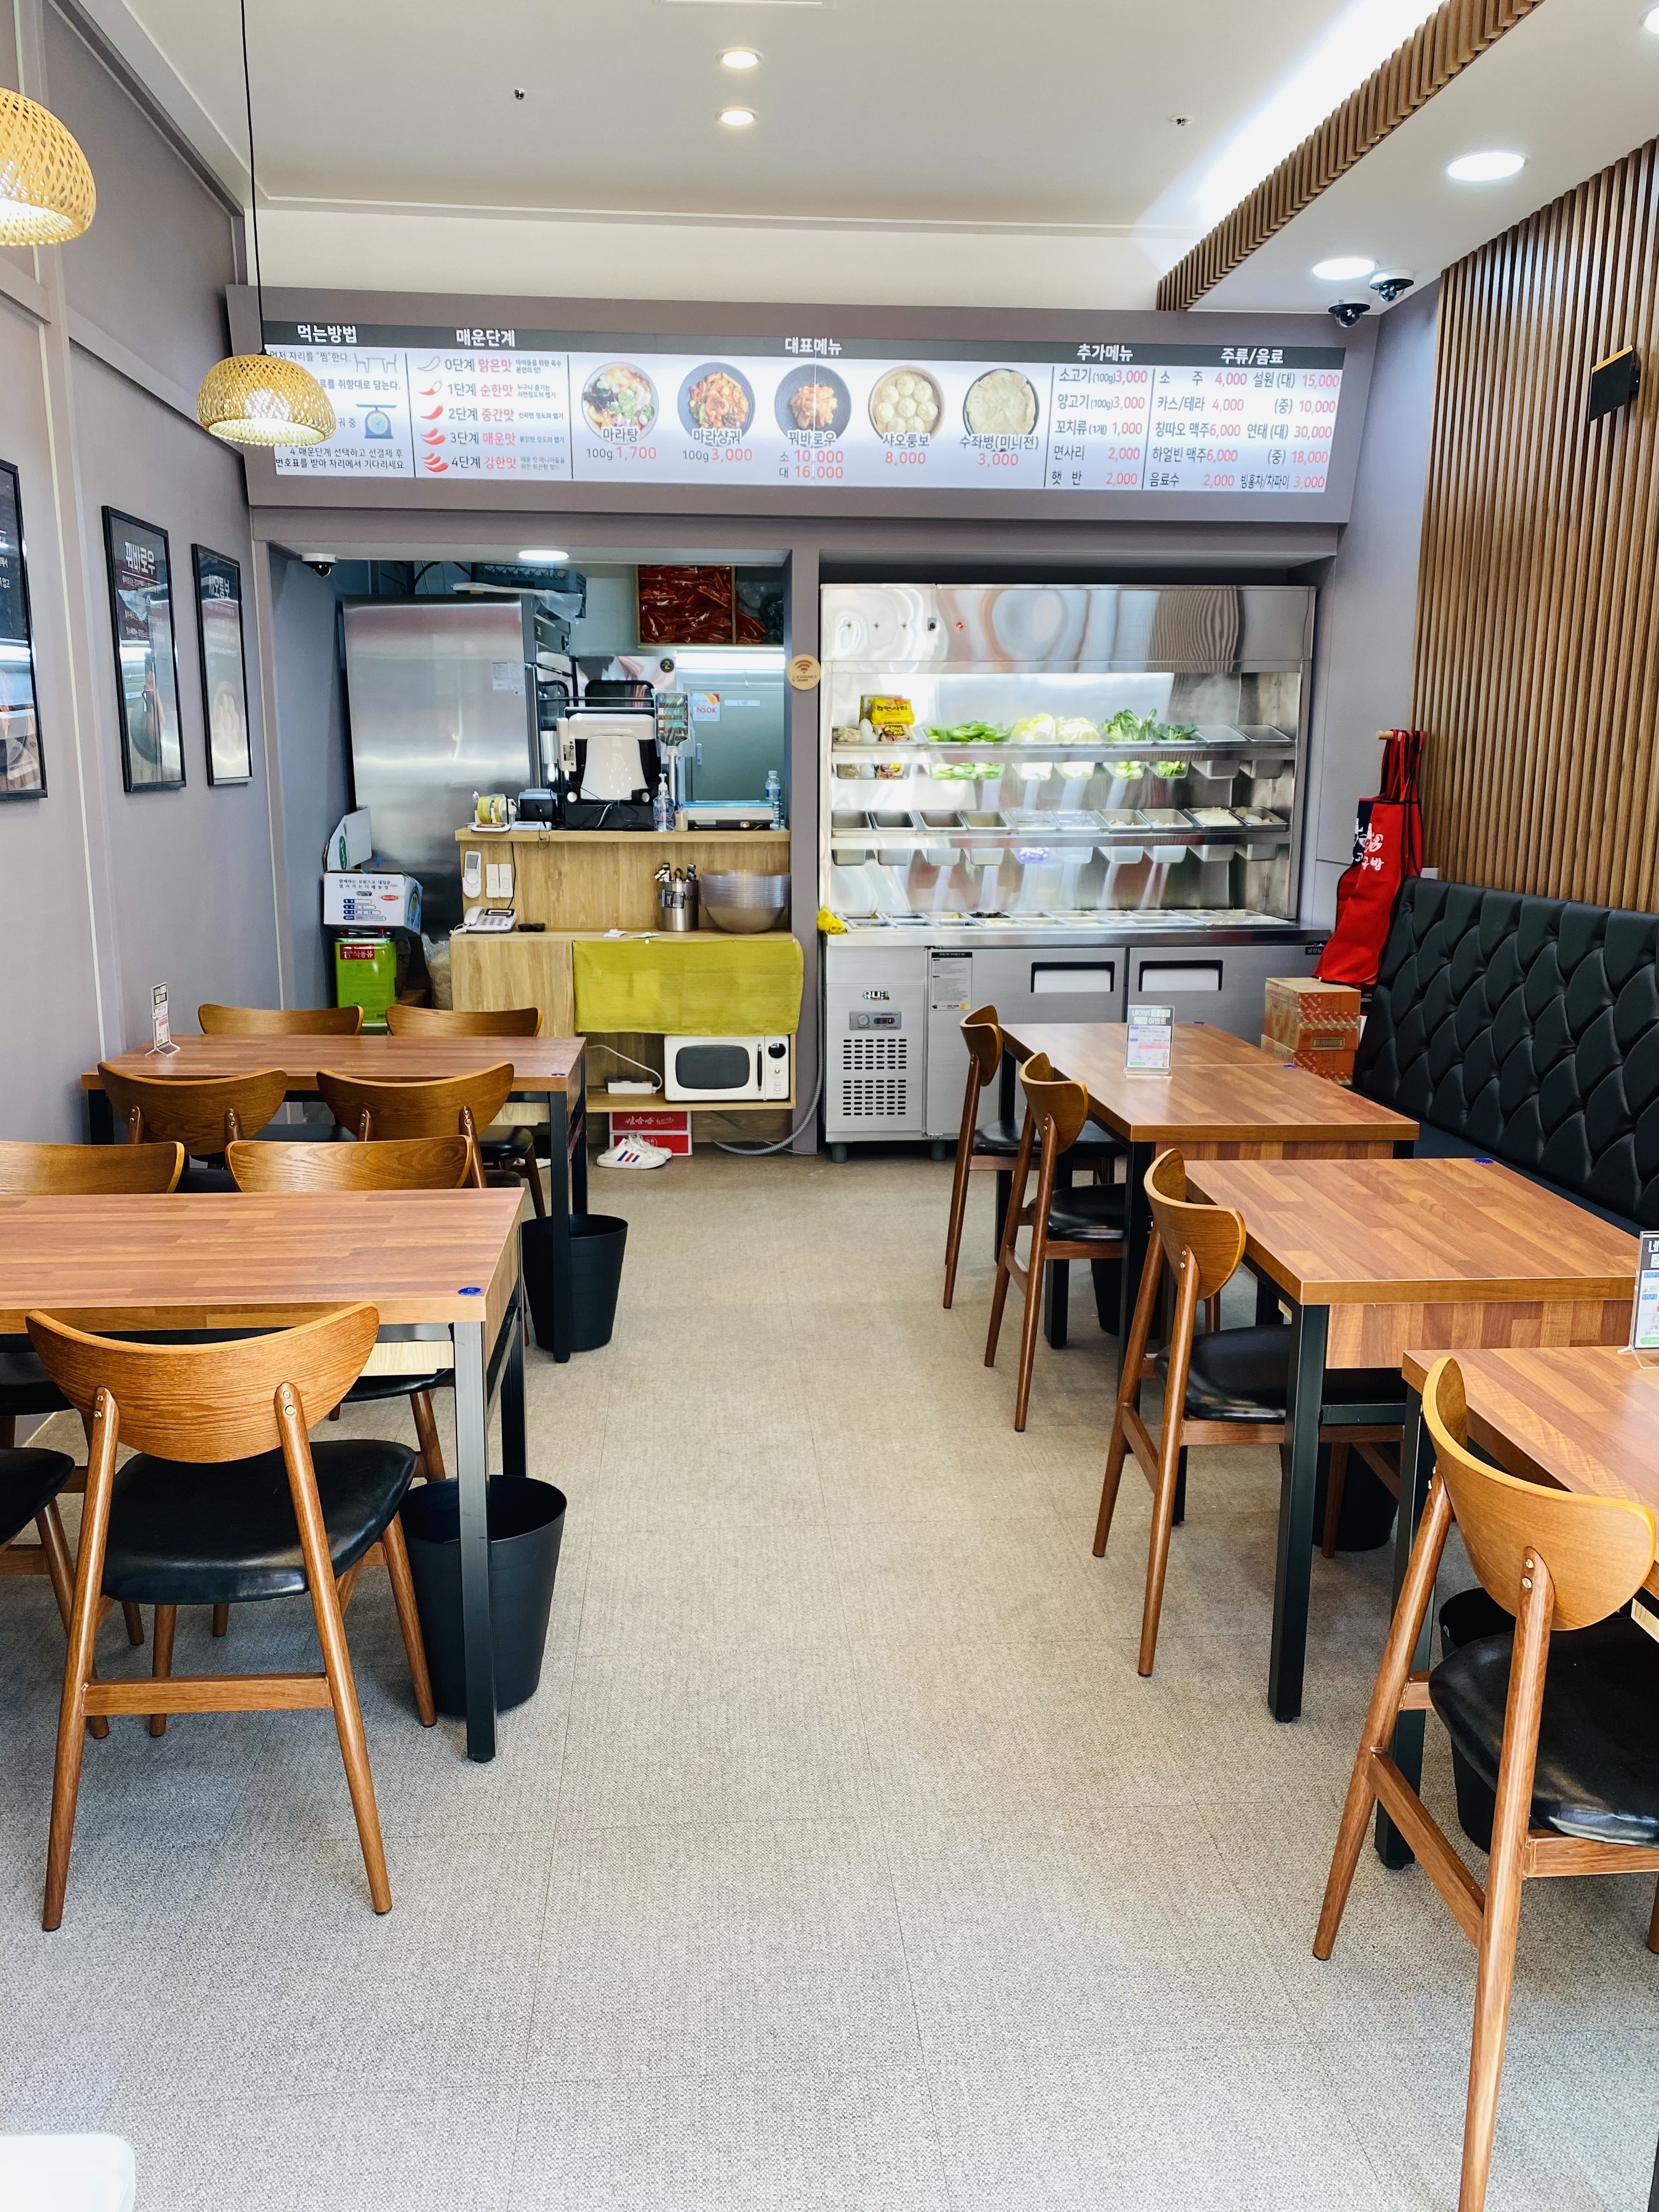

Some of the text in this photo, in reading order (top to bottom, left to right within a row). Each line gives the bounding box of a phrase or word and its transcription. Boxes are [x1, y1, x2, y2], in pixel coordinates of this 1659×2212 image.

[297, 325, 358, 344] 먹는방법
[456, 329, 515, 347] 매운단계
[785, 337, 842, 356] 대표메뉴
[1077, 344, 1133, 362] 추가메뉴
[290, 352, 313, 362] 자리를
[1221, 348, 1284, 365] 주류/음료
[445, 358, 512, 373] 0단계 맑은맛
[318, 379, 335, 389] 료를
[338, 379, 371, 390] 취향대로
[1059, 368, 1148, 385] 소고기 (100g) 3,000
[1215, 373, 1247, 386] 4,000
[1253, 372, 1340, 388] 설원 (대) 15,000
[448, 383, 513, 399] 1단계 순한맛
[1058, 394, 1145, 410] 양고기 (100g) 3,000
[1157, 396, 1244, 412] 카스/테라 4,000
[1274, 398, 1336, 414] (중) 10,000
[449, 408, 515, 422] 2단계 중간맛
[603, 428, 639, 442] 마라탕
[1055, 420, 1143, 436] 꼬치류 (1개) 1,000
[1155, 422, 1241, 438] 칭따오 맥주 6,000
[1247, 423, 1333, 440] 연태 (대) 30,000
[450, 431, 516, 447] 3단계 매운맛
[693, 430, 741, 444] 마라샹궈
[788, 431, 836, 445] 꿔바로우
[883, 433, 930, 447] 샤오룽보
[960, 436, 1039, 450] 수좌병(미니전)
[334, 448, 366, 457] 선택하고
[369, 448, 392, 458] 선결제
[396, 449, 403, 458] 후
[586, 445, 657, 462] 100g 1,700
[682, 448, 752, 464] 100g 3,000
[780, 449, 844, 465] 소 10,000
[885, 452, 926, 466] 8,000
[978, 453, 1019, 468] 3,000
[1054, 445, 1140, 461] 면사리 2,000
[1152, 447, 1238, 464] 하얼빈 맥주 6,000
[1267, 448, 1329, 466] (중) 18,000
[275, 458, 308, 467] 번호표를
[311, 459, 326, 468] 받아
[330, 459, 361, 469] 자리에서
[452, 455, 517, 471] 4단계 강한맛
[780, 465, 844, 481] 대 16,000
[1106, 472, 1137, 486] 2,000
[1149, 472, 1180, 487] 음료수
[1203, 473, 1235, 488] 2,000
[1294, 475, 1325, 489] 3,000
